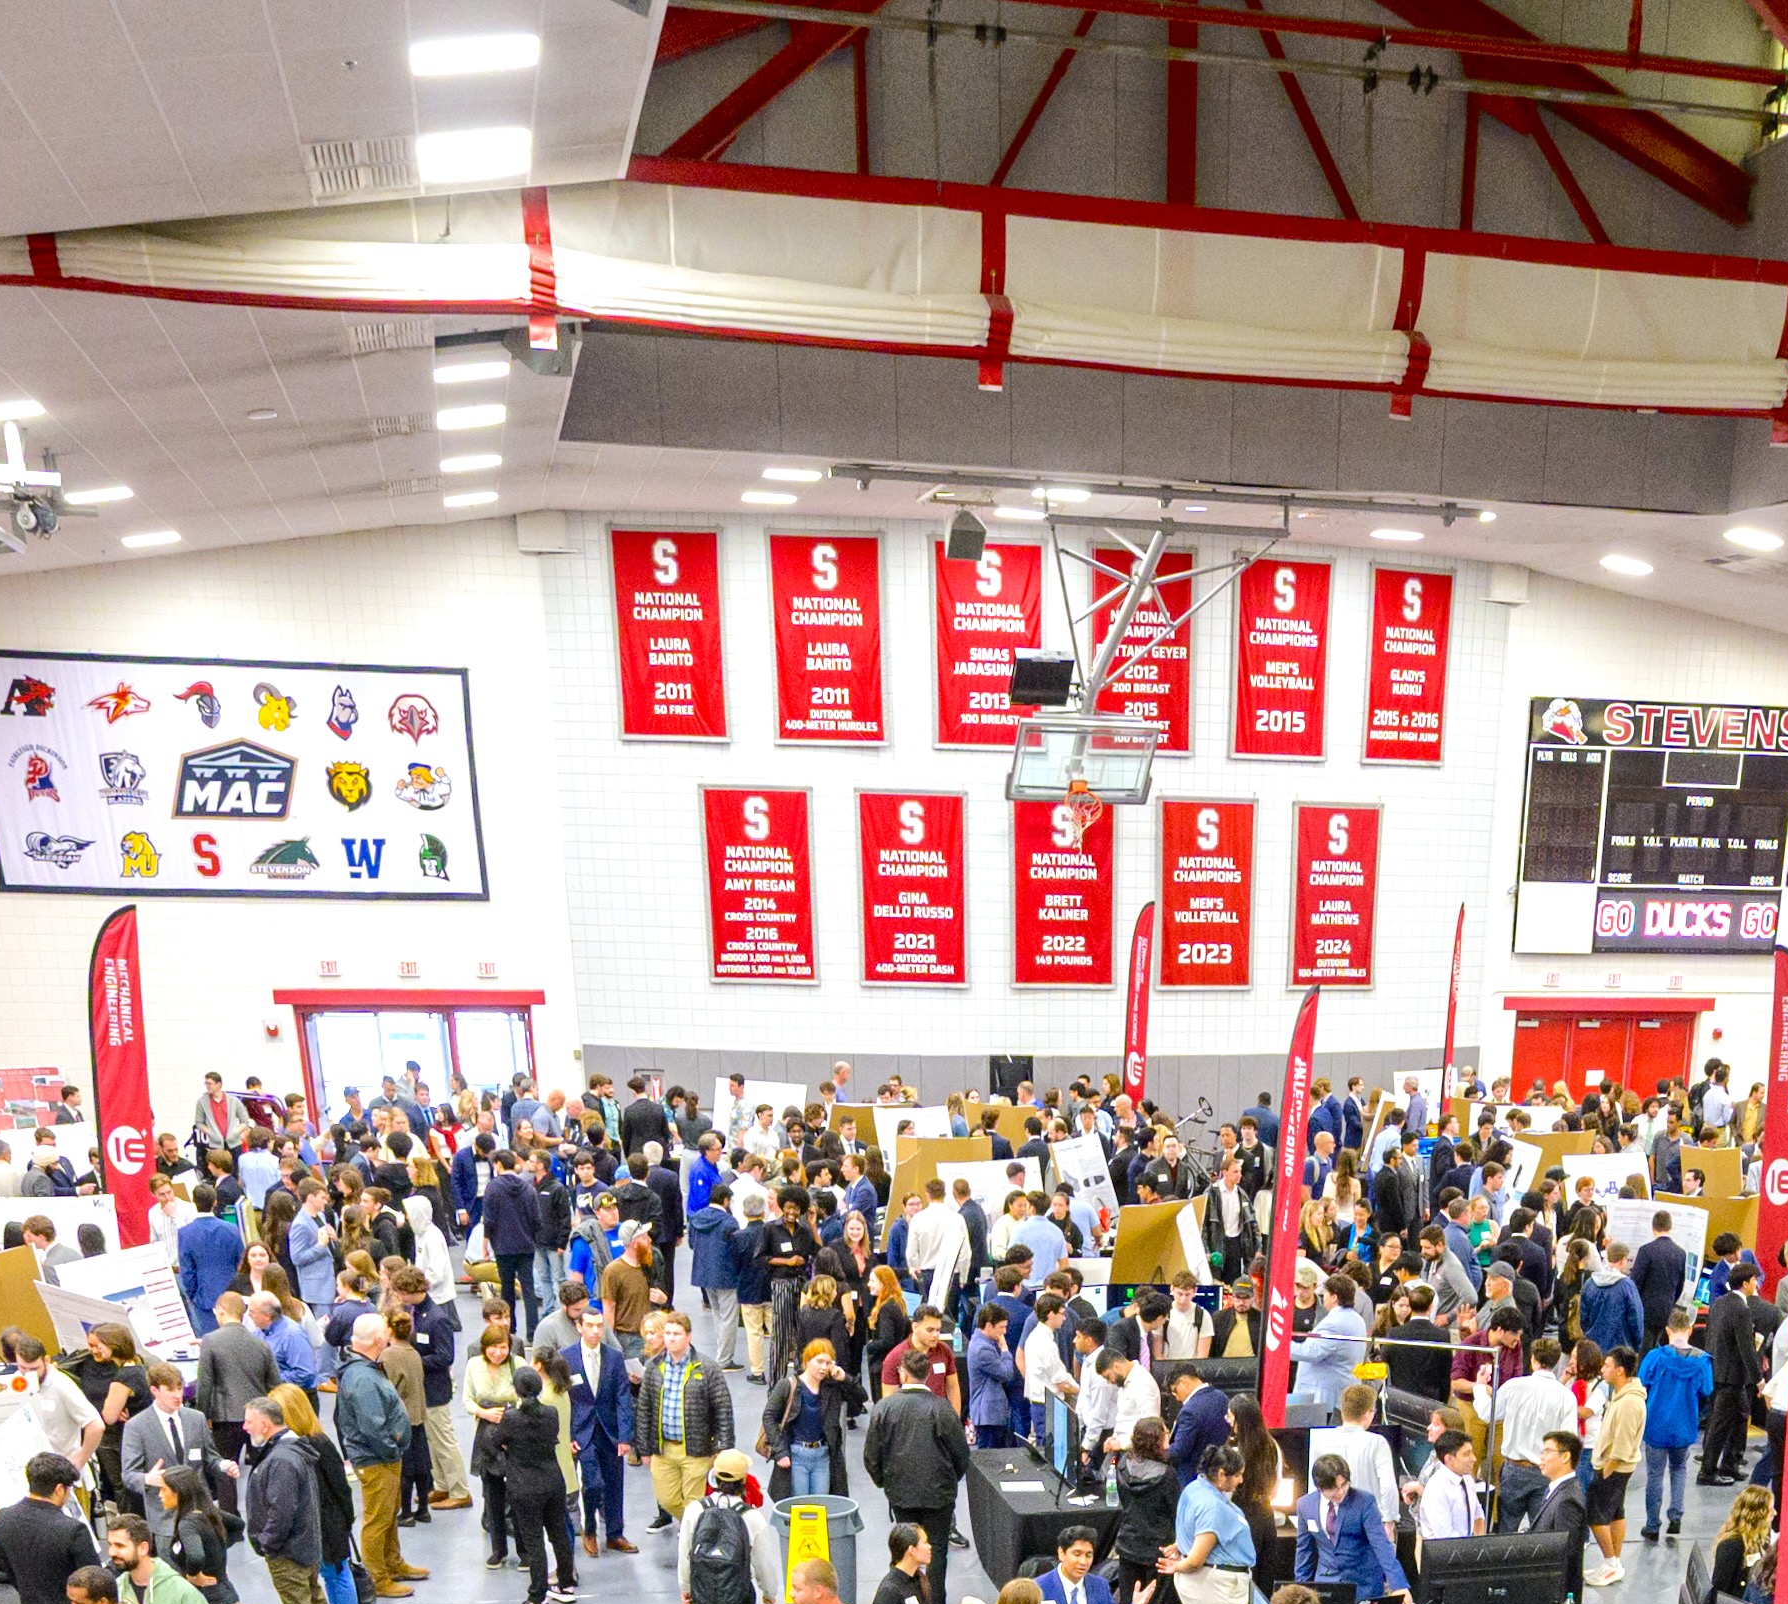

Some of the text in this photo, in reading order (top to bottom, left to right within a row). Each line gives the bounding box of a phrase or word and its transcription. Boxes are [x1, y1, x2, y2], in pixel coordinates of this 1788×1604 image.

[634, 591, 701, 607] NATIONAL
[633, 606, 703, 622] CHAMPION
[1255, 617, 1313, 634] NATIONAL
[1249, 631, 1319, 648] CHAMPIONS
[1385, 626, 1435, 642] NATIONAL
[649, 637, 691, 651] LAURA
[1383, 639, 1436, 656] CHAMPION
[648, 652, 694, 667] BARITO
[1265, 660, 1300, 676] MEN'S
[1390, 668, 1426, 683] GLADYS
[1249, 674, 1315, 691] VOLLEYBALL
[1391, 682, 1423, 697] NJOKU
[655, 683, 691, 699] 2011
[653, 704, 695, 716] 50 FREE
[1256, 710, 1305, 732] 2015
[1373, 710, 1438, 728] 2015 & 2016
[181, 780, 286, 814] MAC
[1685, 795, 1714, 807] PERIOD
[1610, 835, 1636, 847] FOULS
[1669, 836, 1699, 848] PLAYER
[1700, 837, 1721, 849] FOUL
[1754, 838, 1779, 850] FOULS
[725, 845, 792, 860] NATIONAL
[879, 849, 946, 864] NATIONAL
[1031, 852, 1096, 867] NATIONAL
[248, 863, 311, 876] STEVENSON
[724, 859, 794, 874] CHAMPION
[877, 863, 948, 878] CHAMPION
[1178, 856, 1236, 870] NATIONAL
[1029, 866, 1098, 881] CHAMPION
[1173, 869, 1242, 884] CHAMPIONS
[1607, 872, 1775, 886] SCORE MATCH SCORE
[724, 878, 796, 893] AMY REGAN
[744, 897, 777, 911] 2014
[898, 891, 929, 905] GINA
[1045, 894, 1083, 907] BRETT
[1189, 897, 1224, 910] MEN'S
[724, 911, 797, 923] CROSS COUNTRY
[873, 904, 954, 920] DELLO RUSSO
[1038, 907, 1089, 921] KALINER
[1174, 910, 1240, 924] VOLLEYBALL
[1596, 900, 1777, 939] GO DUCKS GO
[894, 933, 935, 950] 2021
[1042, 935, 1086, 952] 2022
[1035, 955, 1093, 966] 149 POUNDS
[1178, 944, 1231, 964] 2023
[105, 958, 121, 1045] ENGINEERING
[117, 959, 133, 1042] MECHANICAL
